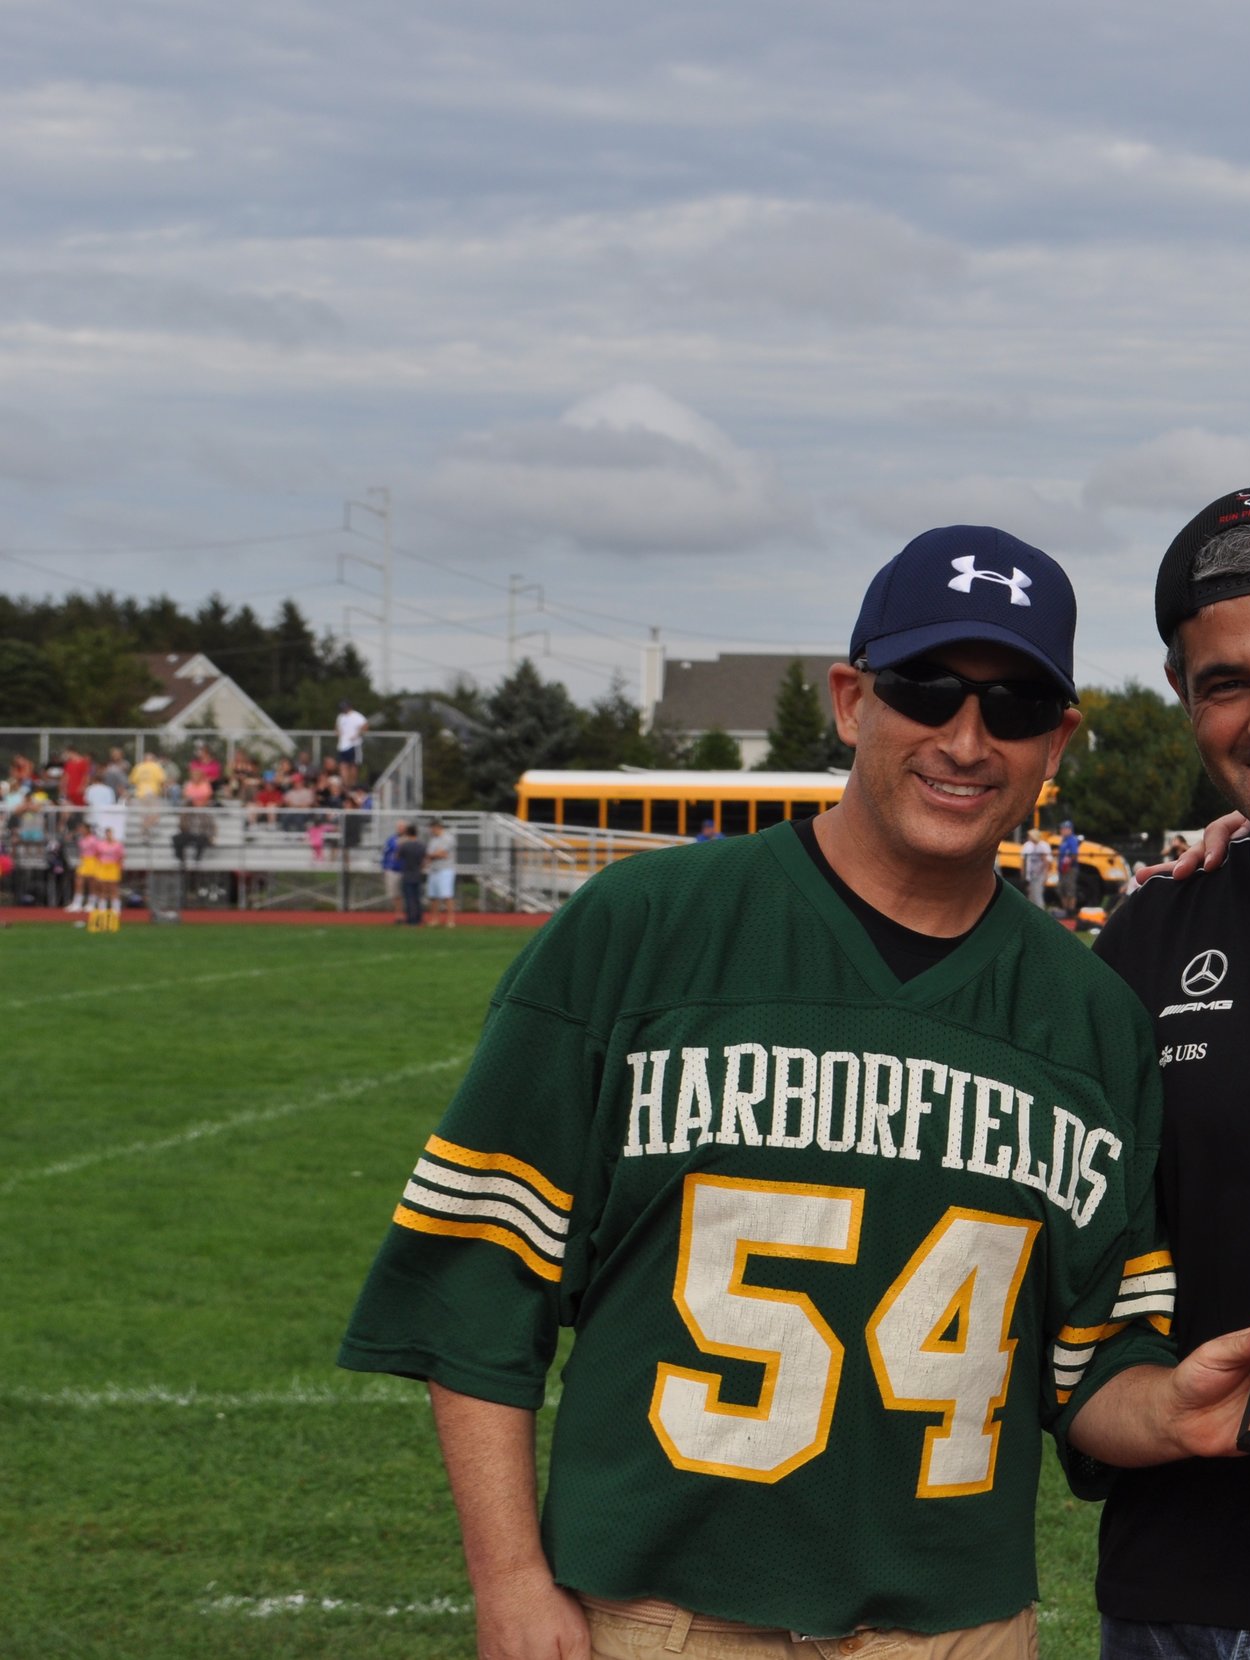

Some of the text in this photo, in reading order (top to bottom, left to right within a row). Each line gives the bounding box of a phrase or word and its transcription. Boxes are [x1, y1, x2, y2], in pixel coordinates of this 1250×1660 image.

[1220, 513, 1239, 524] RUN
[1175, 1042, 1207, 1062] UBS
[623, 1043, 1122, 1229] HARBORFIELDS
[648, 1172, 1043, 1498] 54
